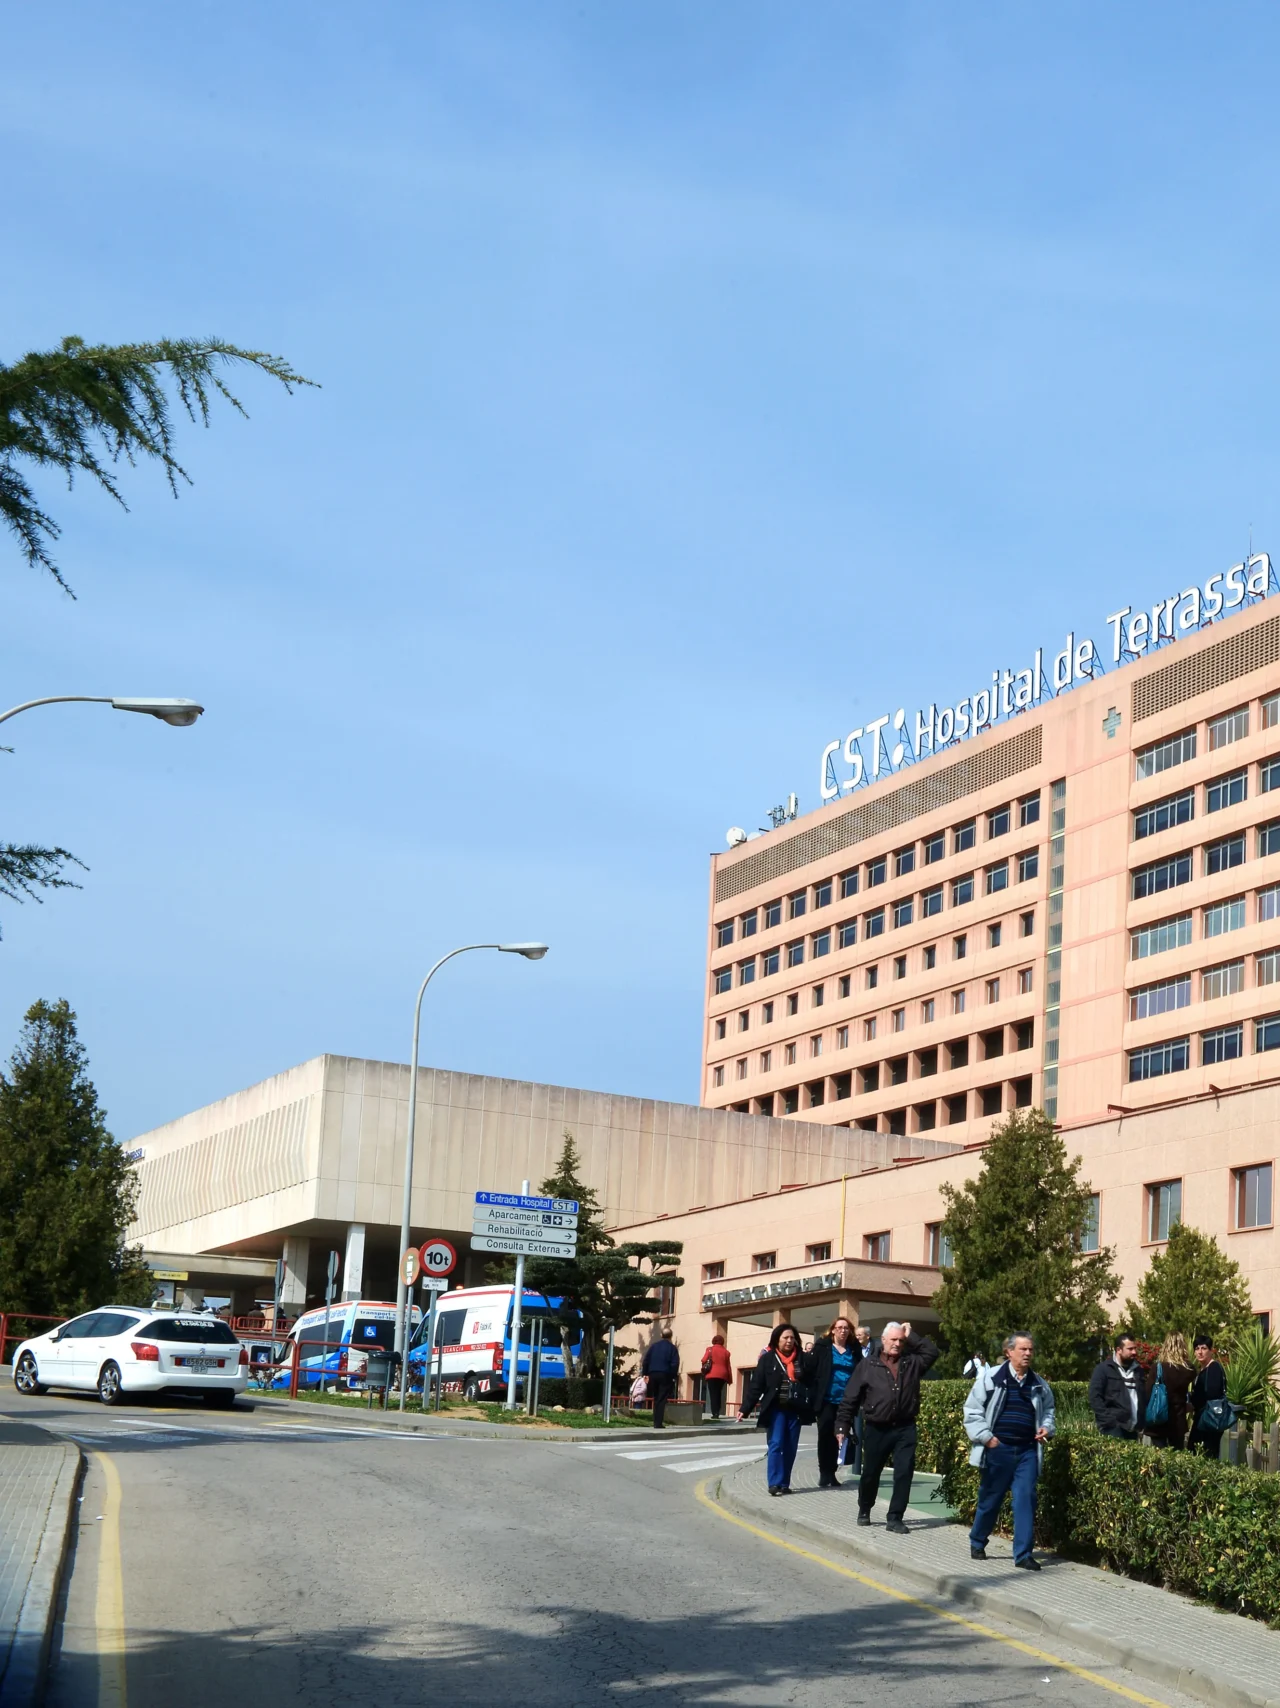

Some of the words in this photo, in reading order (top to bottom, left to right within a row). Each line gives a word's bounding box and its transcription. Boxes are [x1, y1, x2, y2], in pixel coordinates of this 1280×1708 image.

[914, 646, 1043, 757] Hospital
[1053, 631, 1095, 690] de
[1106, 552, 1271, 662] Terrassa
[489, 1193, 518, 1205] Entrada
[520, 1197, 550, 1209] Hospital
[488, 1209, 539, 1222] Aparcament
[487, 1224, 543, 1238] Rehabilitació
[486, 1239, 524, 1251] Consulta
[528, 1243, 560, 1254] Externa
